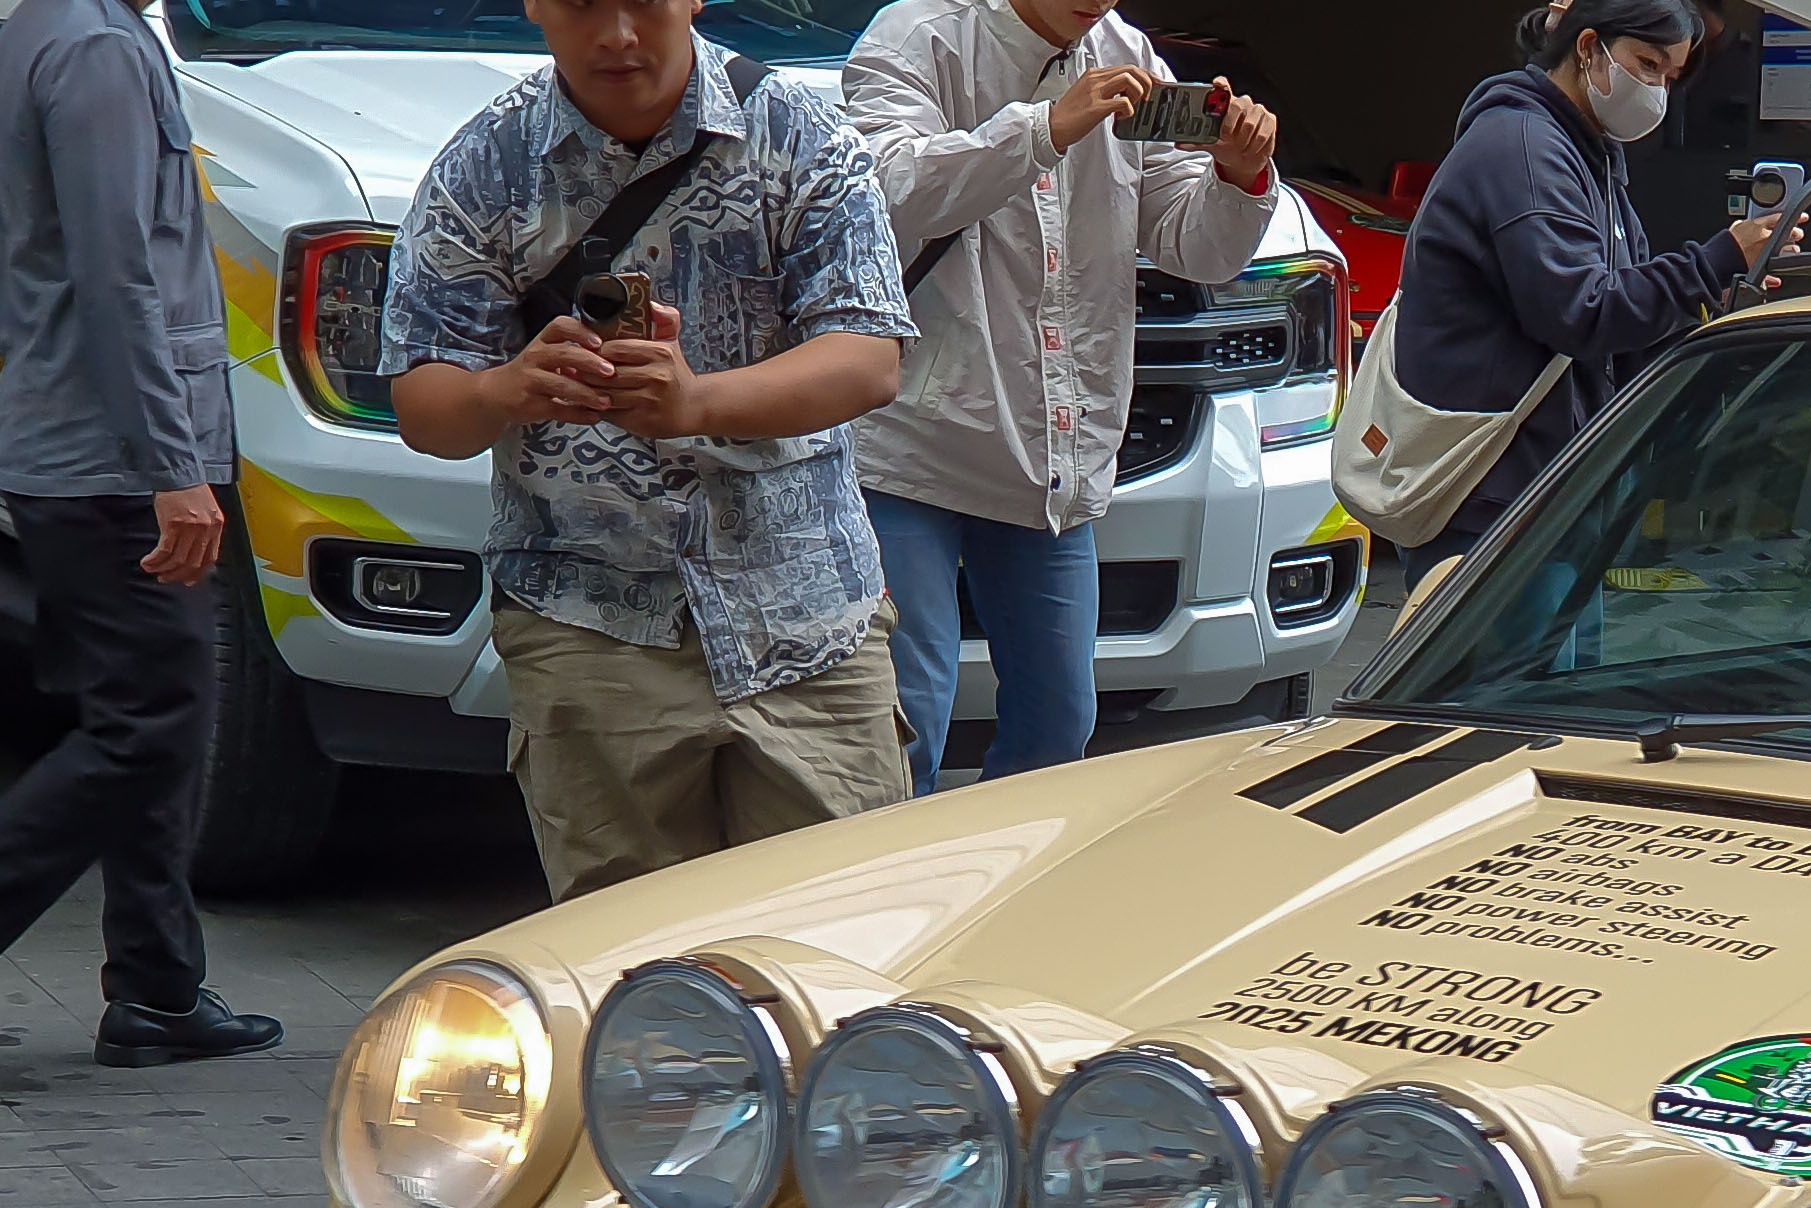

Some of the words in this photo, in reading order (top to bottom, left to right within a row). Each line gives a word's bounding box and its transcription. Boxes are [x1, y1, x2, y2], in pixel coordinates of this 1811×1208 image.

[1492, 843, 1566, 861] NO
[1560, 853, 1640, 869] abs
[1532, 829, 1631, 850] 400
[1626, 838, 1707, 860] km
[1709, 853, 1748, 865] a
[1561, 814, 1662, 835] from
[1660, 825, 1755, 844] BAY
[1744, 836, 1794, 851] to
[1425, 875, 1501, 894] NO
[1492, 882, 1615, 909] brake
[1615, 900, 1751, 930] assist
[1459, 859, 1534, 877] NO
[1526, 868, 1685, 896] airbags
[1357, 909, 1434, 930] NO
[1419, 921, 1655, 964] problems...
[1391, 891, 1467, 911] NO
[1452, 902, 1601, 928] power
[1598, 919, 1779, 961] steering
[1233, 977, 1355, 1007] 2500
[1346, 991, 1434, 1018] KM
[1424, 1006, 1556, 1041] along
[1269, 951, 1352, 981] be
[1354, 961, 1604, 1016] STRONG
[1197, 1001, 1326, 1034] 2025
[1310, 1016, 1523, 1063] MEKONG
